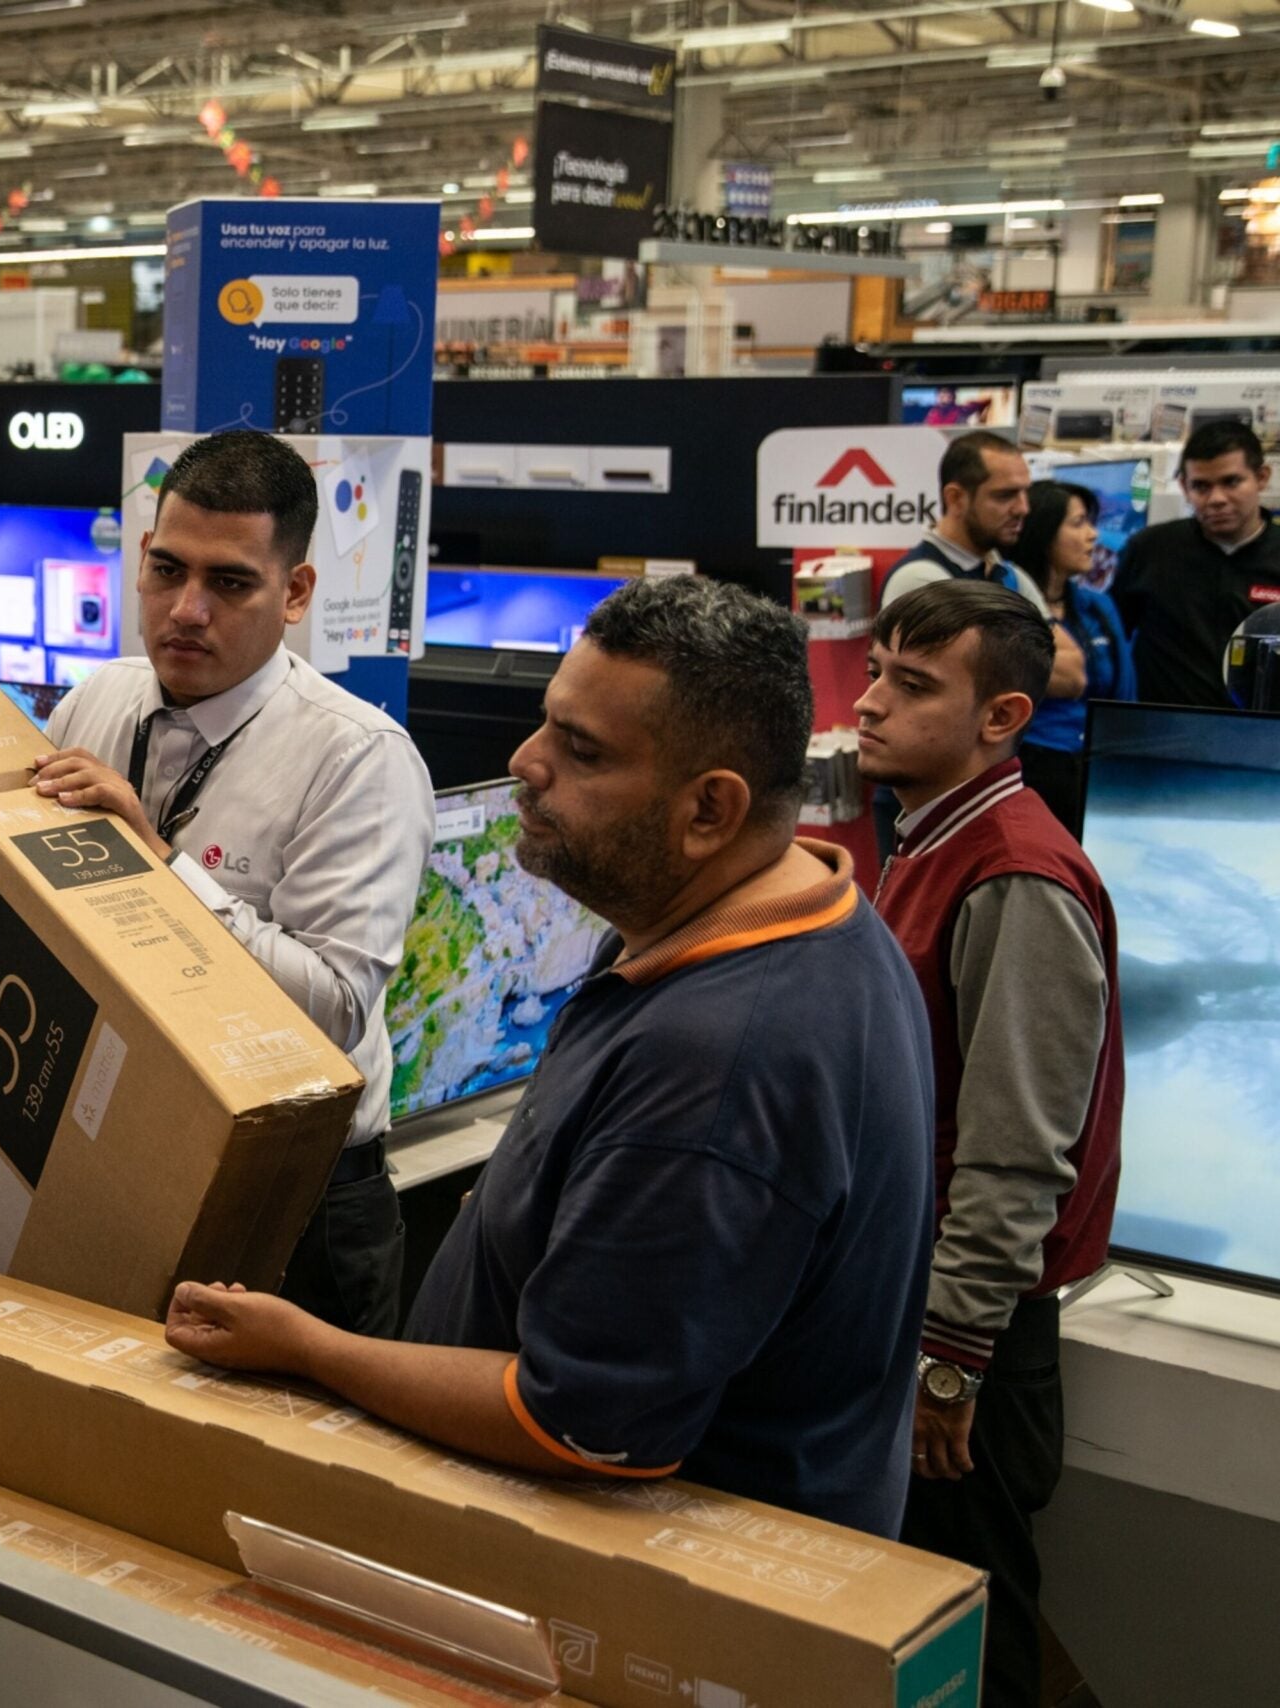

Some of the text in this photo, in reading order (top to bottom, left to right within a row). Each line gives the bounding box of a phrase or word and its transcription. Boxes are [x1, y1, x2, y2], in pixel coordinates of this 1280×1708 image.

[221, 223, 326, 239] Usa tu voz para
[220, 236, 285, 249] encender
[288, 239, 299, 252] y
[299, 239, 351, 253] apagar
[353, 238, 366, 249] la
[272, 287, 342, 298] Solo tienes
[274, 301, 300, 313] que
[9, 411, 84, 449] OLED
[773, 493, 938, 525] finlandek
[323, 597, 350, 613] Google
[191, 770, 205, 785] LG
[41, 828, 109, 867] 55
[224, 851, 250, 875] LG
[72, 869, 93, 881] 139
[181, 964, 207, 978] CB
[22, 1083, 43, 1122] 139
